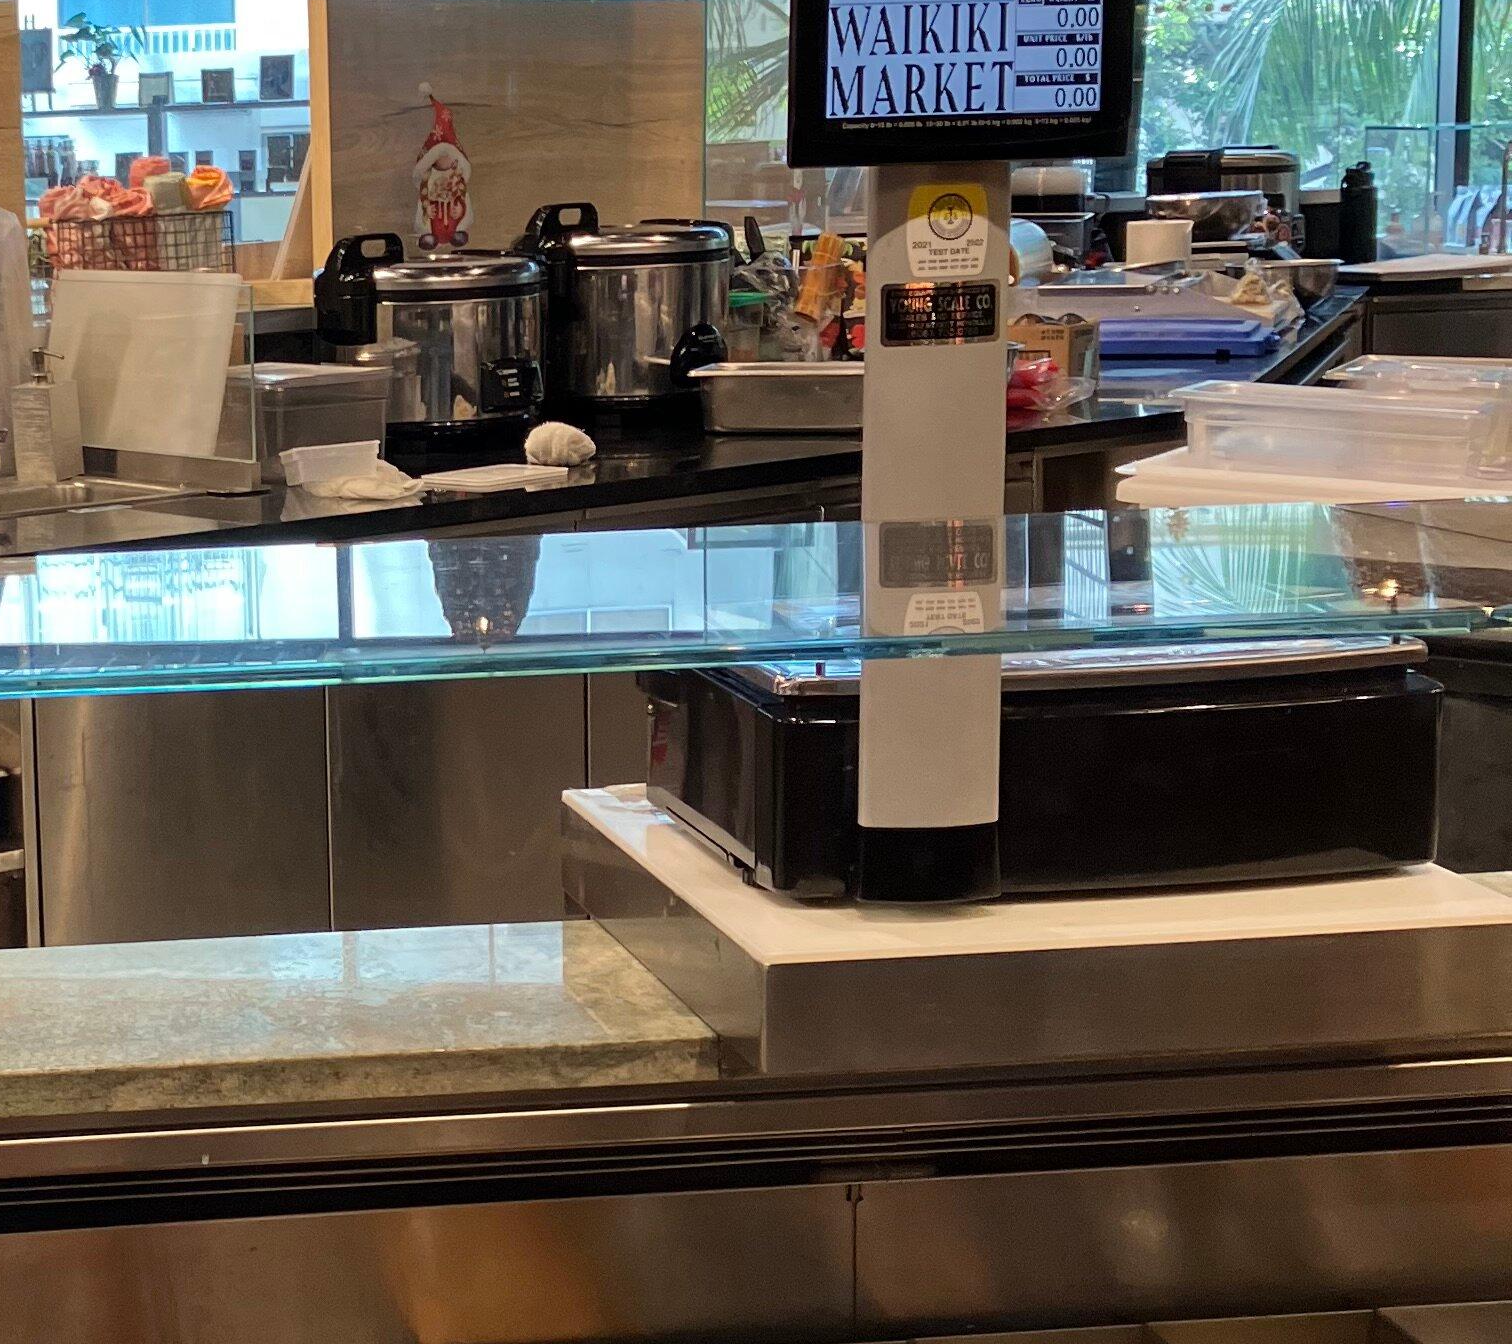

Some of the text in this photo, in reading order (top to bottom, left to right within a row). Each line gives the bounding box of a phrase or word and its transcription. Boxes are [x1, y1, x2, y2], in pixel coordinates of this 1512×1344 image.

[1057, 7, 1099, 28] 0.00
[829, 2, 1010, 56] WAIKIKI
[1023, 33, 1068, 43] UNIT PRICE
[1056, 47, 1098, 68] 0.00
[829, 61, 1014, 117] MARKET
[1024, 73, 1076, 84] TOTAL PRICE
[1055, 87, 1097, 108] 0.00
[928, 247, 970, 256] TEST DATE
[889, 296, 933, 313] YOUNG
[937, 295, 971, 311] SCALE
